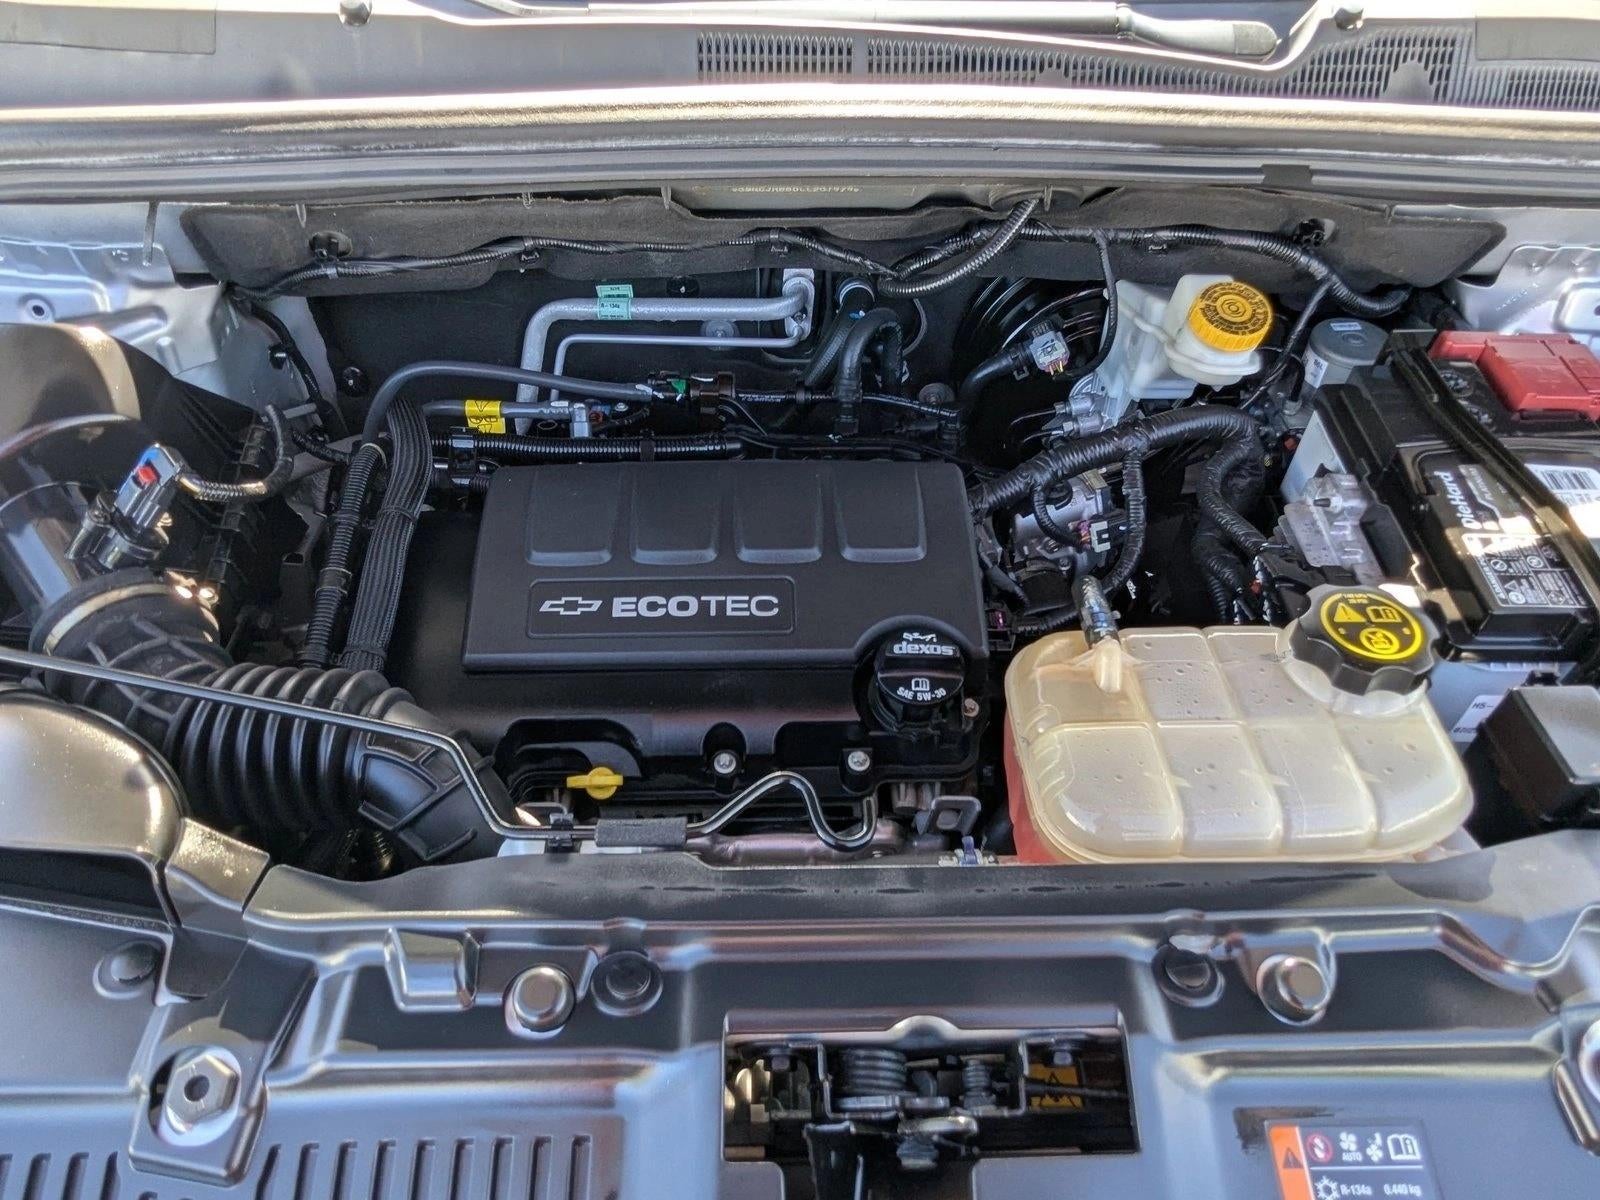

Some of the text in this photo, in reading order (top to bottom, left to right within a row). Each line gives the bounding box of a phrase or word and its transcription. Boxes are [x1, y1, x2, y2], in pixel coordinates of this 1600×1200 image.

[1434, 471, 1484, 530] DieHard
[612, 595, 779, 618] ECOTEC
[893, 641, 955, 656] dexos
[897, 687, 947, 701] SAE 5W-30
[1342, 1152, 1363, 1161] AUTO
[1340, 1184, 1372, 1196] R-134a
[1409, 1184, 1422, 1197] kg
